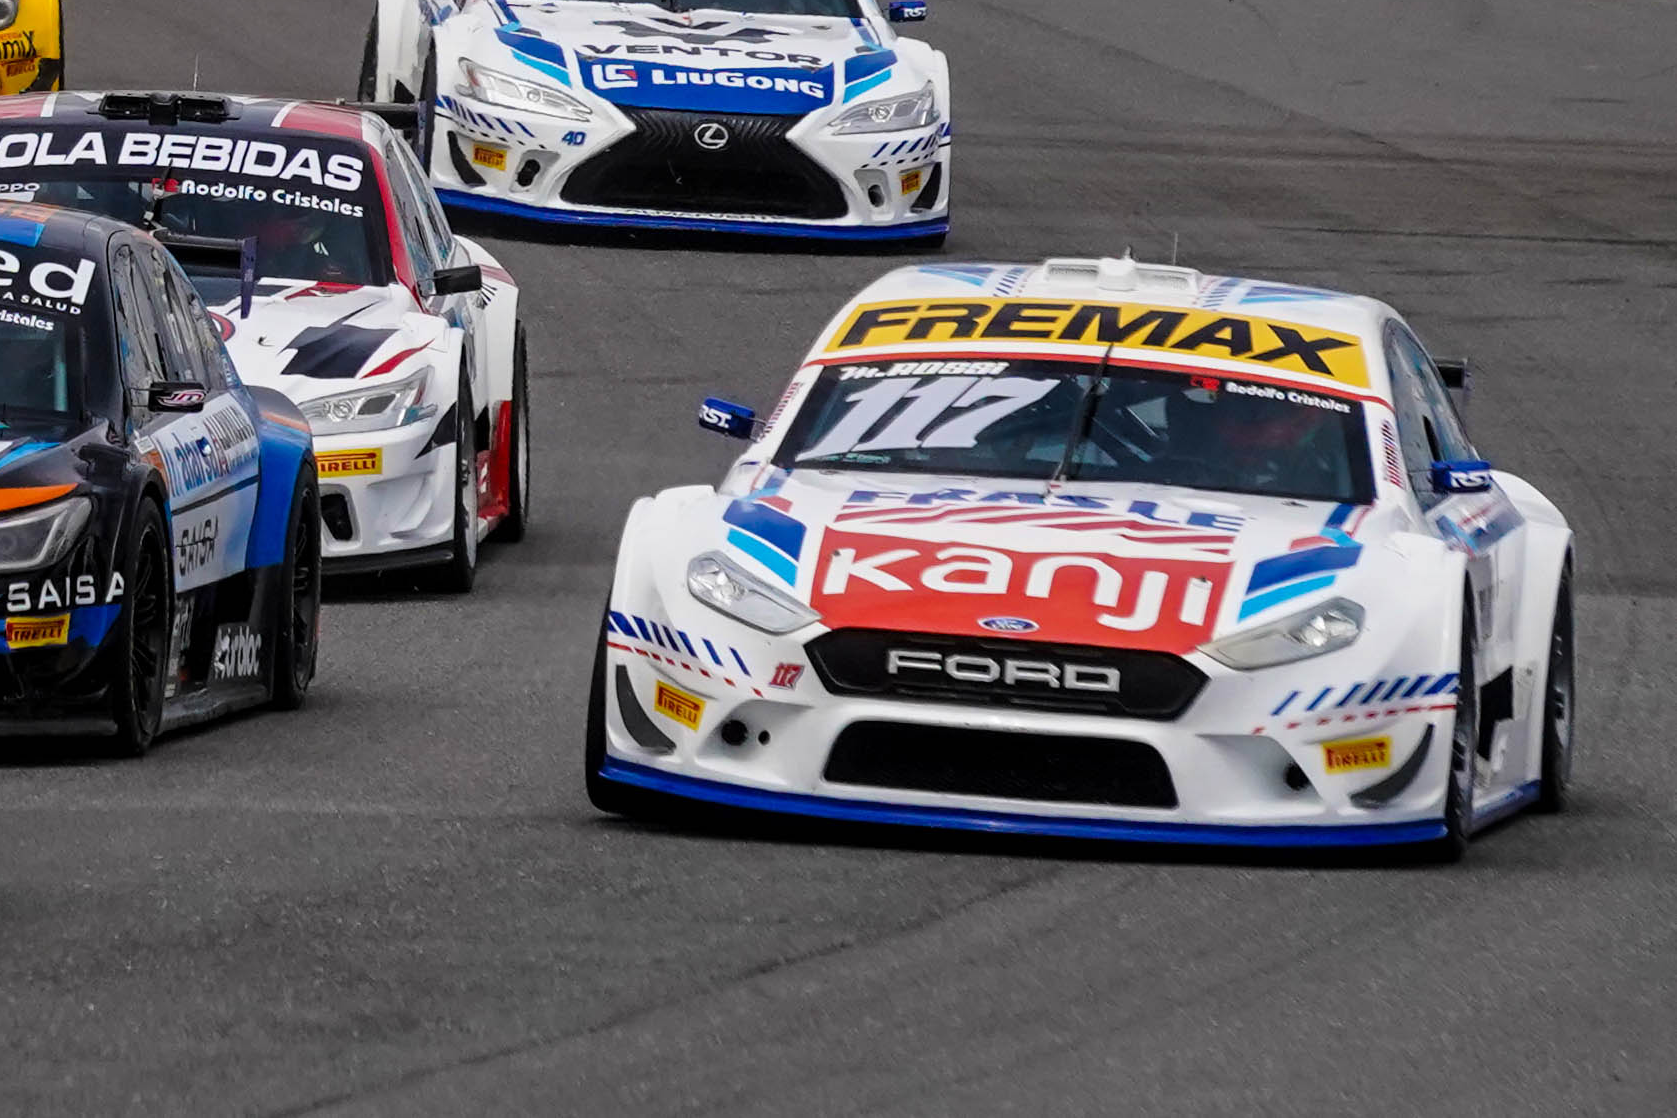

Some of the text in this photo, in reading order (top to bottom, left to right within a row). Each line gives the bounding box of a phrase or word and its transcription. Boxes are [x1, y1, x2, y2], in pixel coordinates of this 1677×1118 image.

[583, 43, 823, 66] VENTOR
[560, 130, 587, 146] 40
[118, 134, 364, 192] BEBIDAS
[181, 179, 364, 219] Rodolfo Cristales
[19, 291, 81, 316] SALUD
[837, 301, 1361, 377] FREMAX
[795, 376, 1062, 463] 117
[316, 451, 377, 474] IRELLI
[6, 571, 125, 612] SAISA
[769, 662, 806, 690] 117
[887, 649, 1121, 693] FORD
[658, 686, 701, 724] PIRELLI
